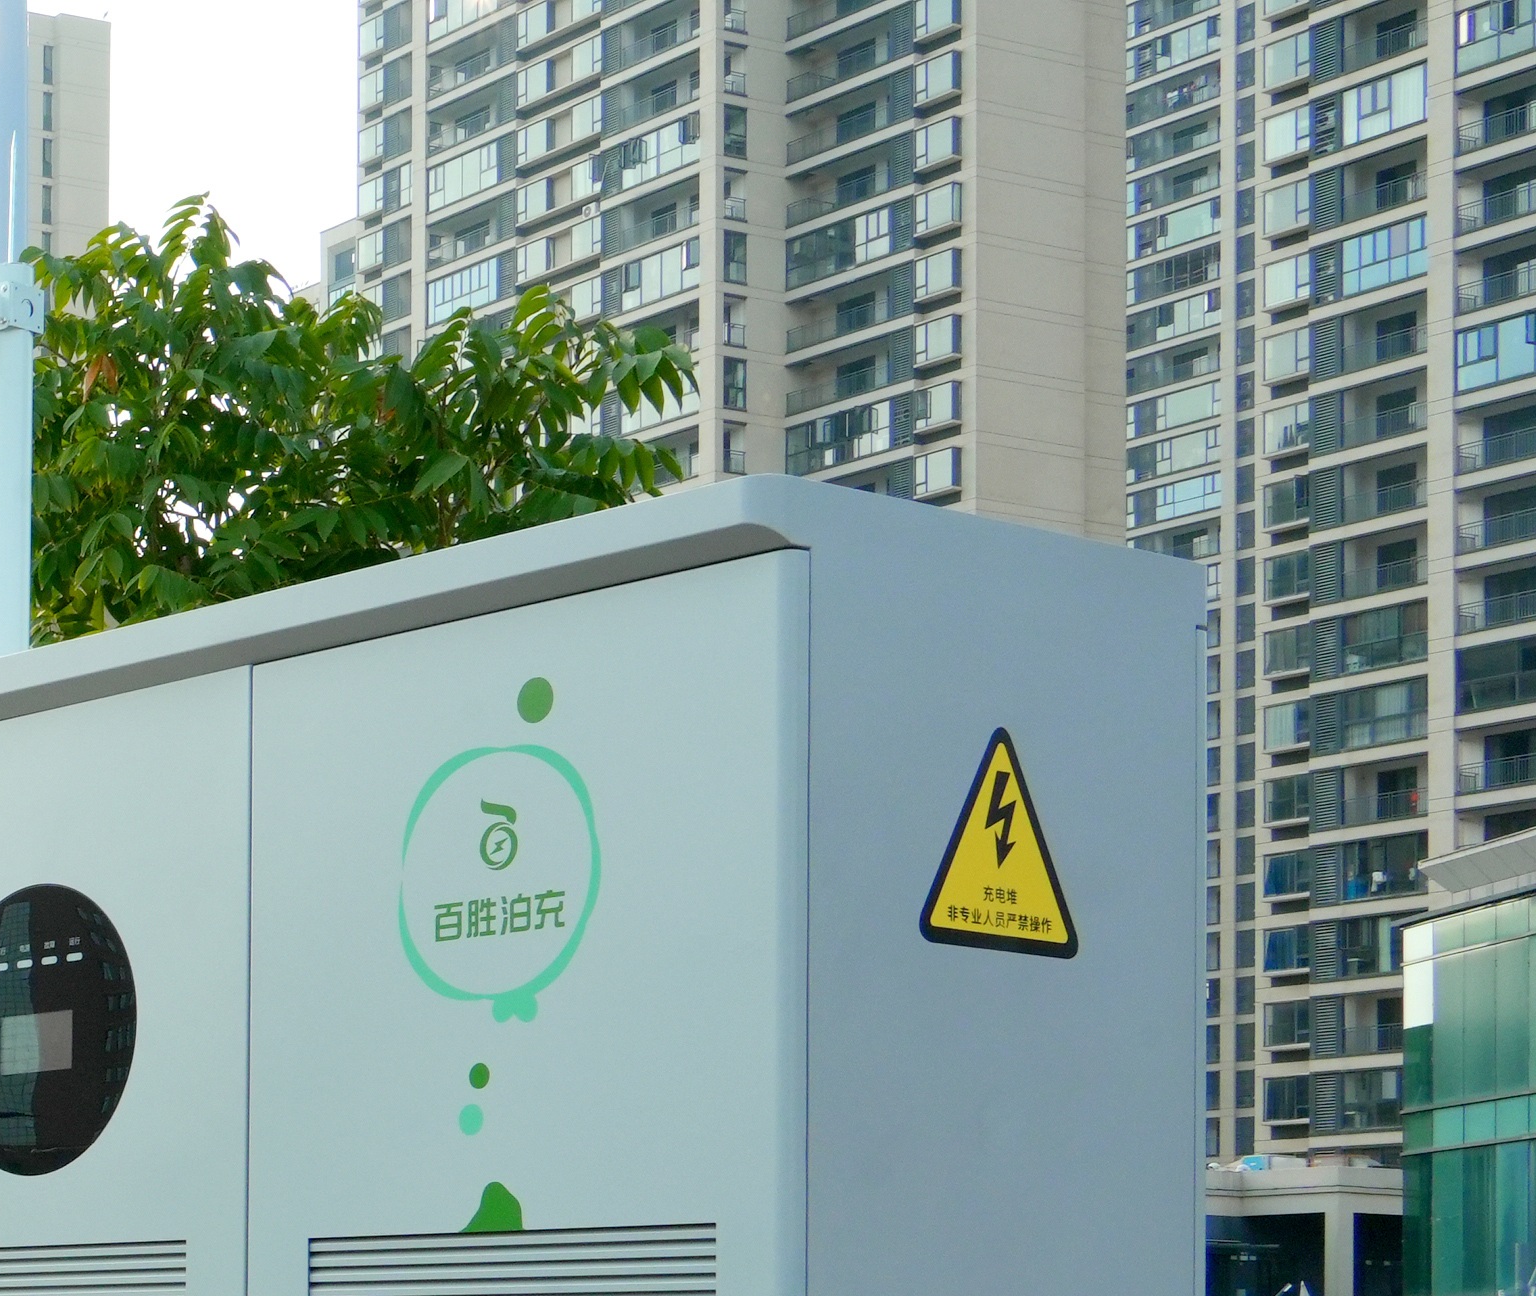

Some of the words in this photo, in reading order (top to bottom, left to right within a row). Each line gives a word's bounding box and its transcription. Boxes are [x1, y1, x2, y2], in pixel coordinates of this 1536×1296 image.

[983, 886, 1018, 905] 充电堆
[434, 890, 565, 942] 百胜泊充
[947, 905, 1053, 934] 非专业人员严禁操作
